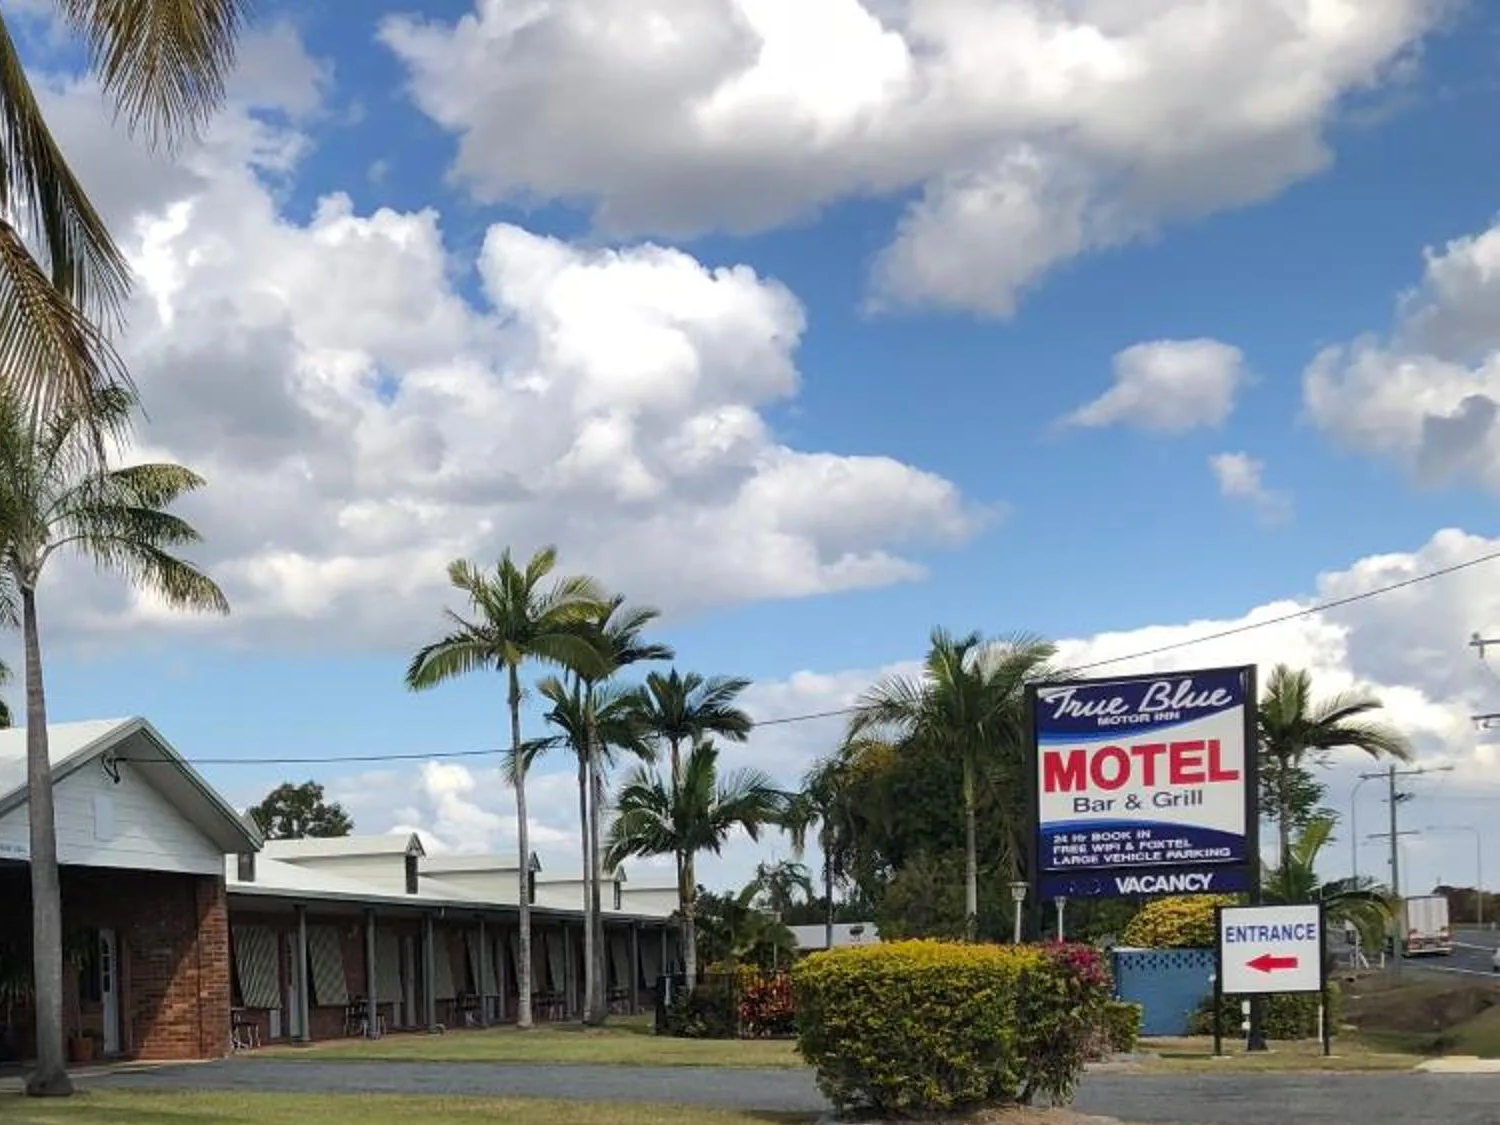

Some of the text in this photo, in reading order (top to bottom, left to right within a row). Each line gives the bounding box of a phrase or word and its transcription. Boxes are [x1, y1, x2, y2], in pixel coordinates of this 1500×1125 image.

[1045, 679, 1232, 719] True Blue
[1097, 711, 1181, 726] MOTOR INN
[1043, 739, 1240, 793] MOTEL
[1073, 789, 1203, 813] Bar & Grill
[1053, 835, 1068, 844] 24
[1091, 831, 1131, 842] BOOK
[1137, 829, 1151, 839] IN
[1053, 844, 1087, 855] FREE
[1125, 841, 1135, 851] &
[1139, 838, 1192, 851] FOXTEL
[1053, 846, 1231, 865] LARGE VEHICLE PARKING
[1115, 873, 1213, 894] VACANCY
[1225, 923, 1317, 943] ENTRANCE
